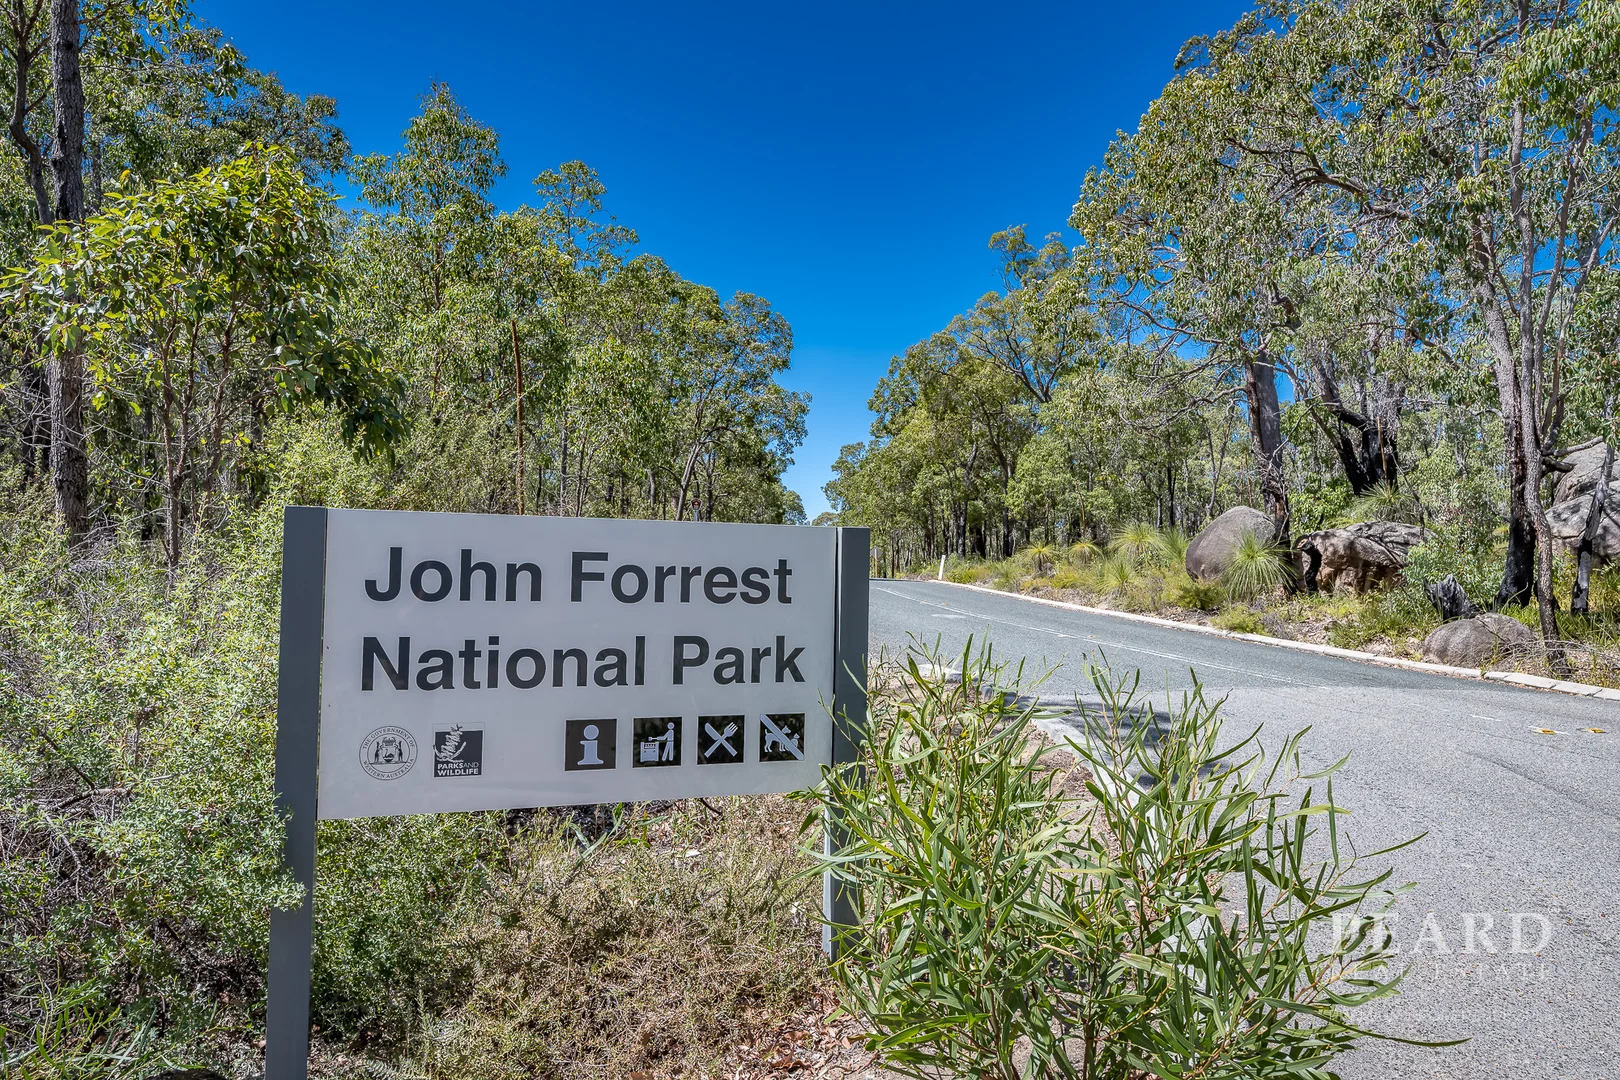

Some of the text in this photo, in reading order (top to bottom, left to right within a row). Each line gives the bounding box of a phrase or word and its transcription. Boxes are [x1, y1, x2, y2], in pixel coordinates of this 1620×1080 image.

[364, 546, 793, 605] John Forrest
[361, 635, 806, 692] National Park
[371, 727, 412, 741] GOVERNMENT
[363, 758, 414, 778] WESTERN AUSTRALIA
[437, 767, 479, 776] WILDLIFE
